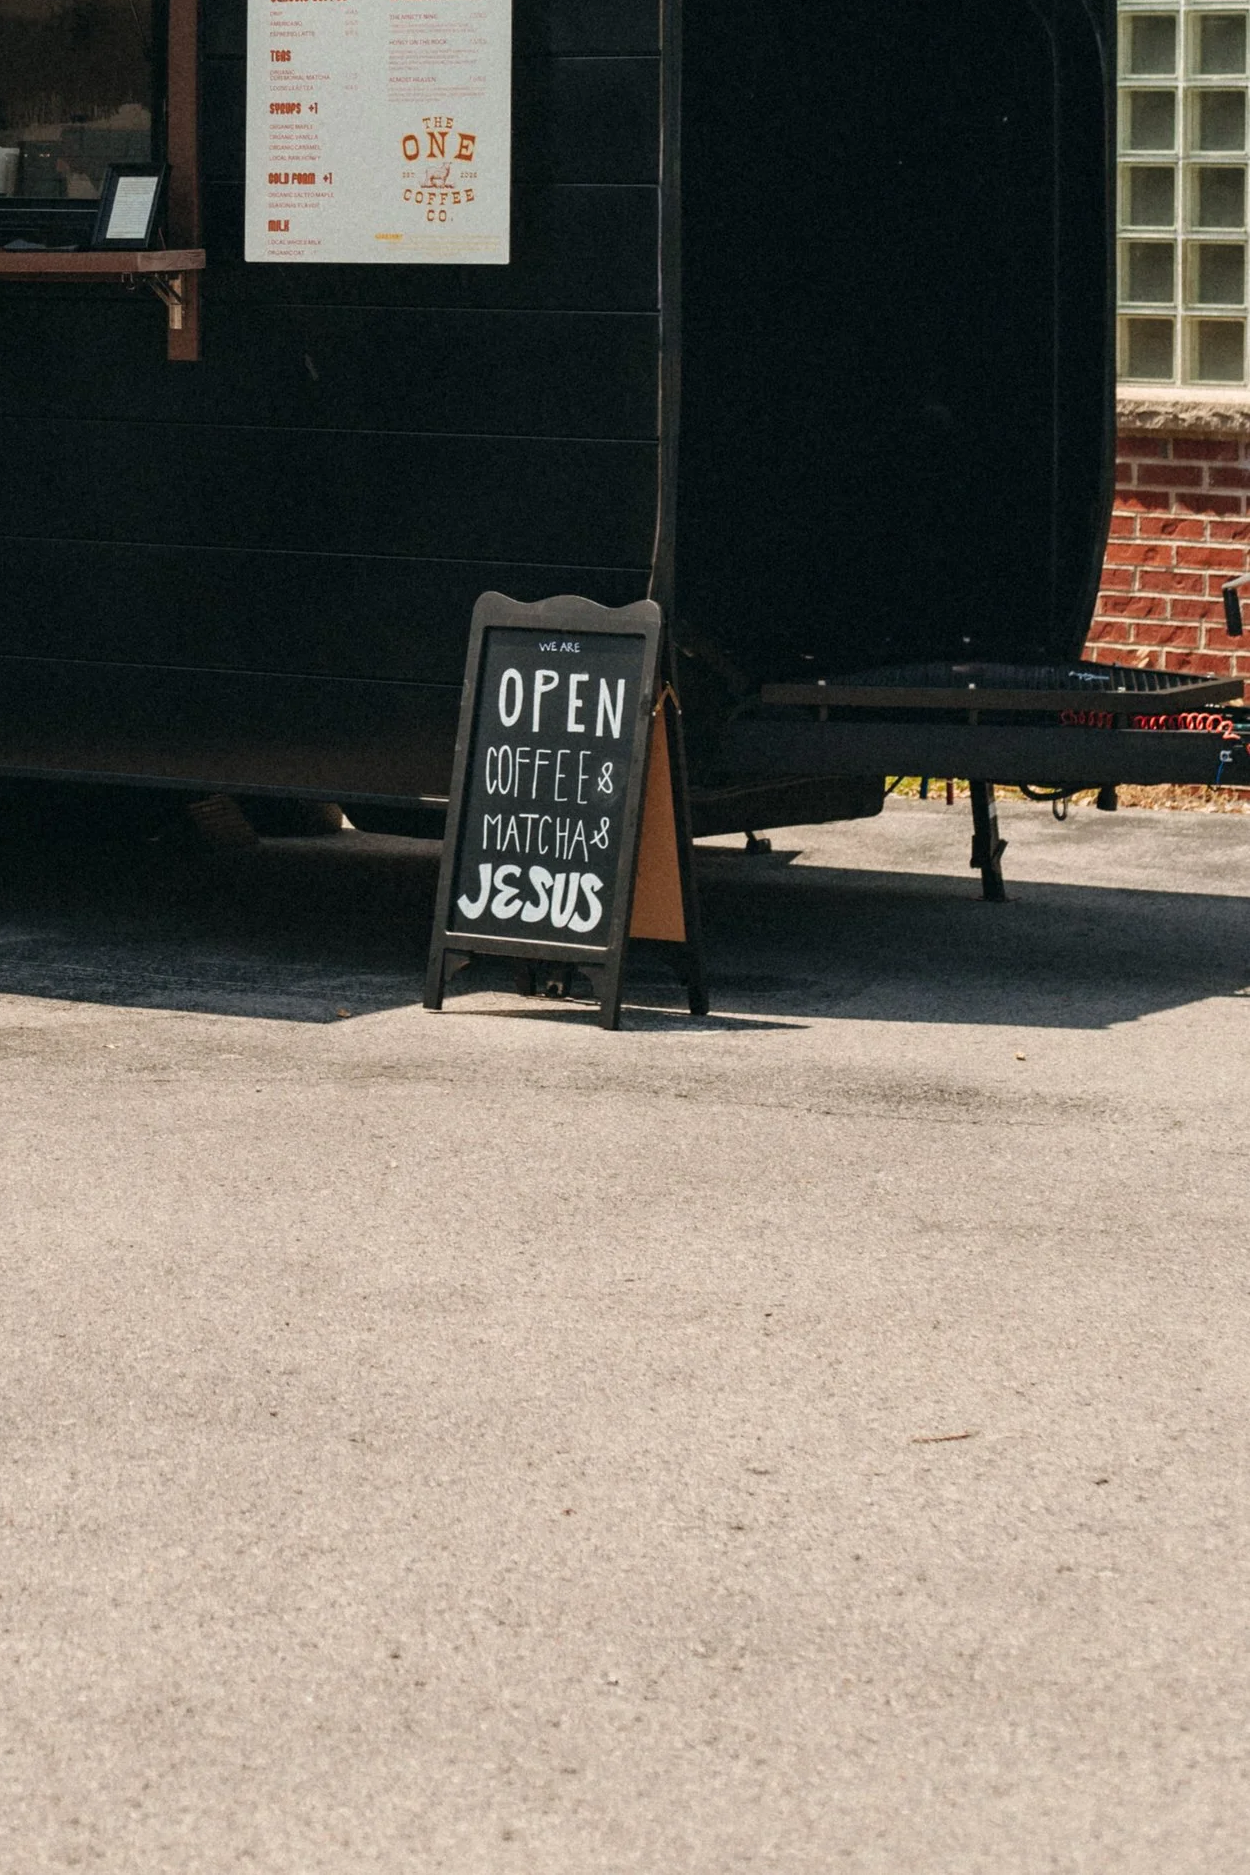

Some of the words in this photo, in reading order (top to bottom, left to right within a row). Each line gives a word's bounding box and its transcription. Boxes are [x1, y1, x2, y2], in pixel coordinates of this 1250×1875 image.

[270, 49, 291, 63] TEAS
[269, 102, 302, 115] SYRUPS
[308, 101, 318, 115] +1
[422, 116, 454, 129] THE
[402, 131, 476, 162] ONE
[268, 172, 289, 185] COLD
[323, 172, 333, 185] +1
[403, 188, 475, 205] COFFEE
[427, 209, 454, 222] CO.
[268, 219, 289, 232] MILK
[539, 641, 558, 653] WE
[559, 642, 581, 653] ARE
[498, 667, 626, 739] OPEN
[485, 745, 592, 805] COFFEE
[457, 862, 604, 933] JESUS
